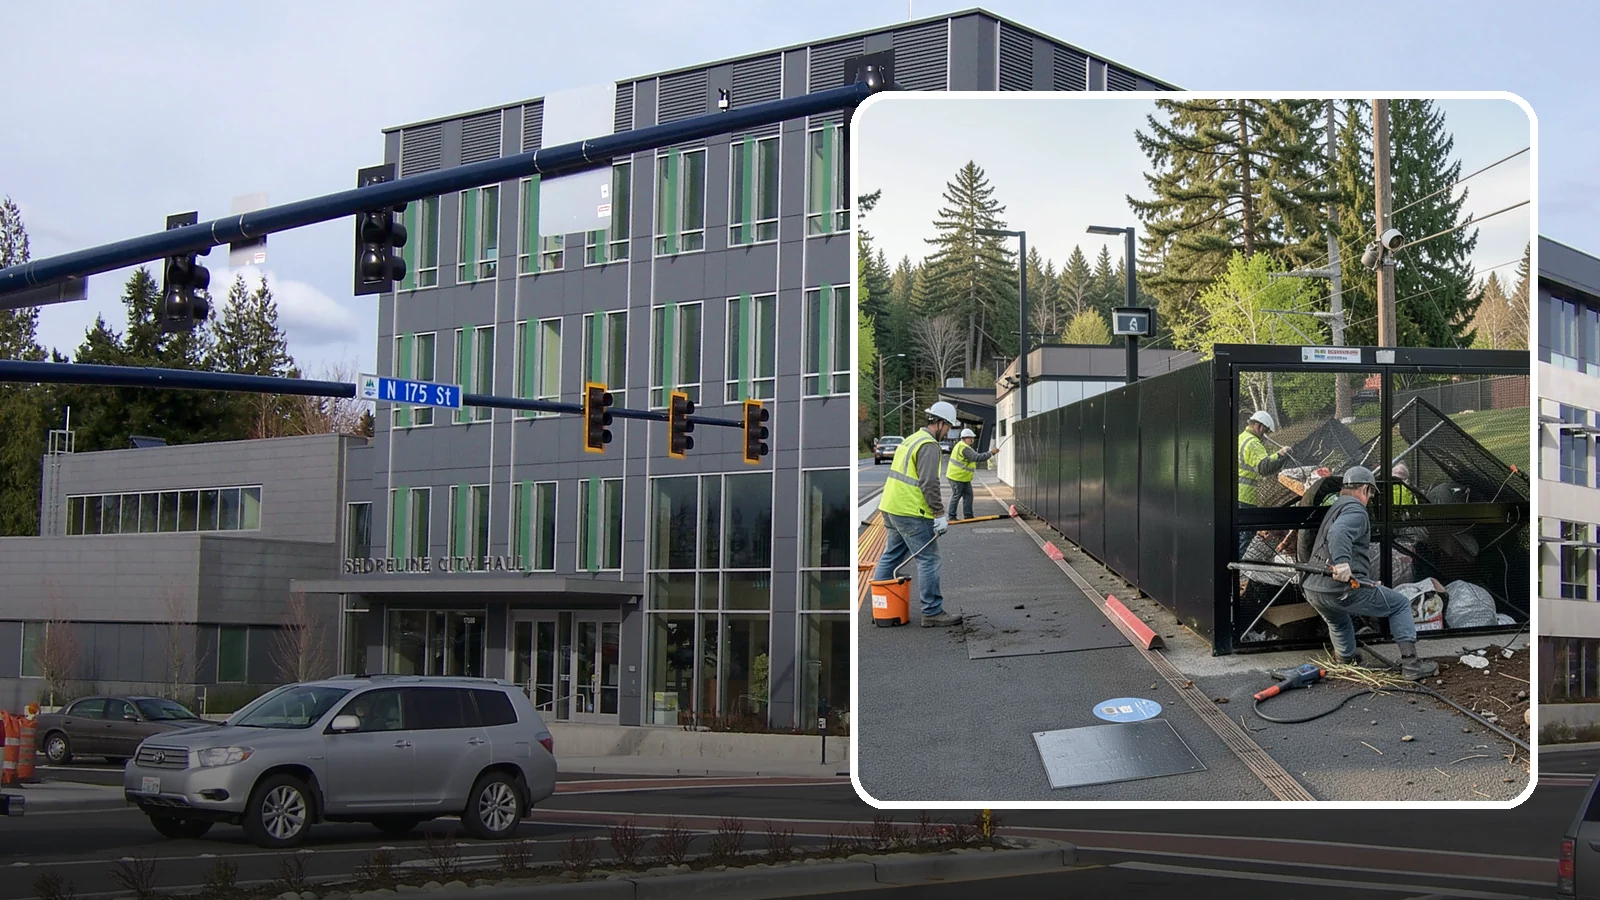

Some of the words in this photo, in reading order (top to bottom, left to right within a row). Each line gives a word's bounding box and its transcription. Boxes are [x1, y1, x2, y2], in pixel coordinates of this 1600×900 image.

[387, 380, 396, 399] N
[405, 382, 427, 403] 175
[436, 386, 451, 406] St
[344, 556, 431, 574] SHORELINE
[438, 556, 475, 572] CITY
[483, 555, 526, 571] HALL
